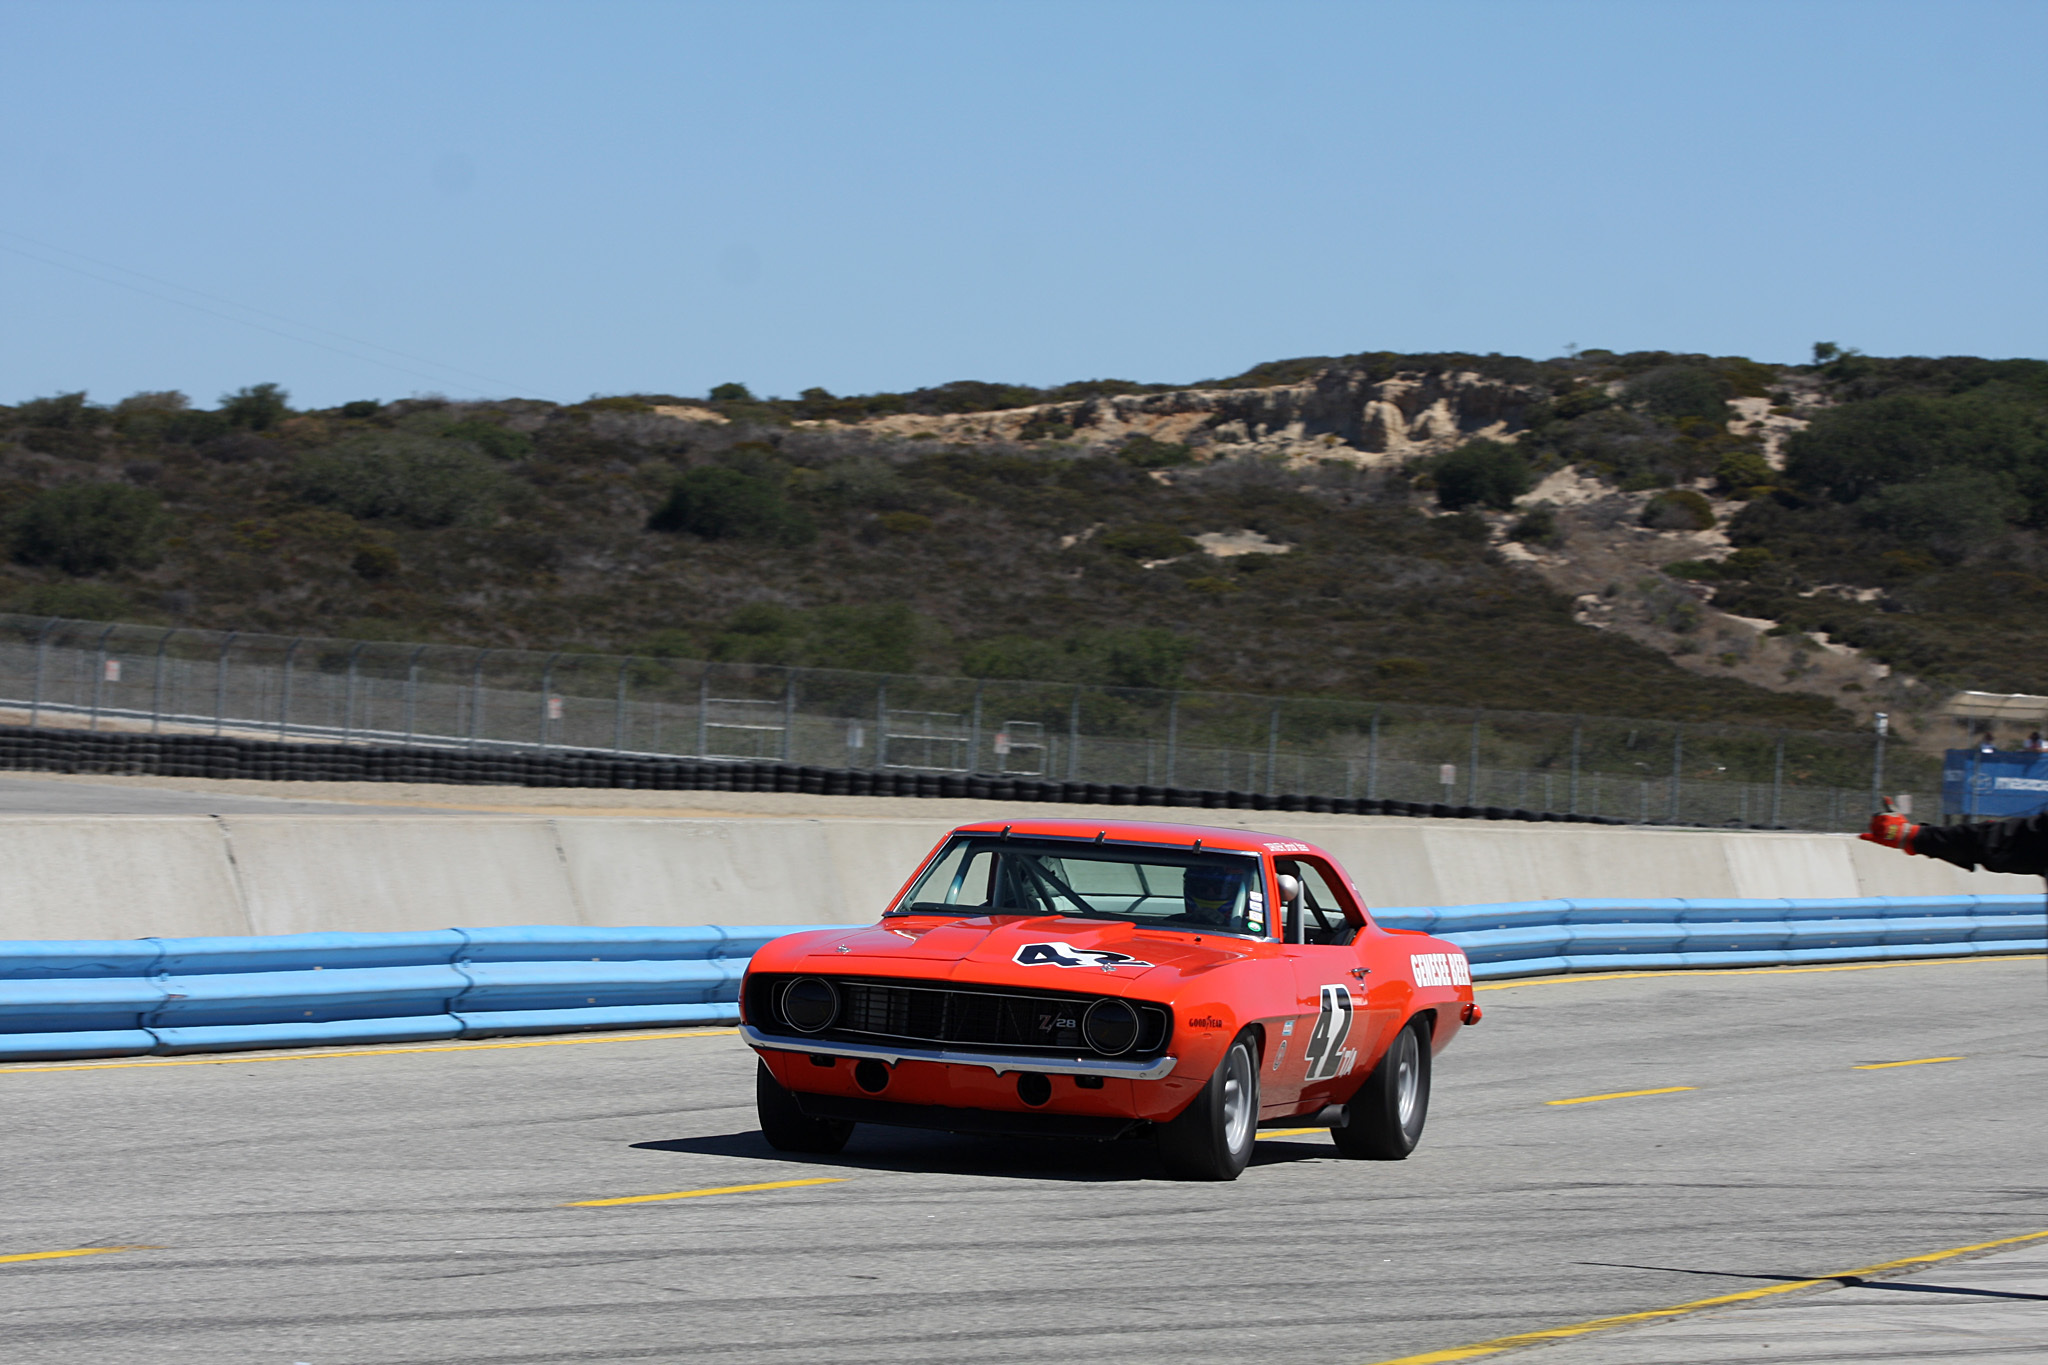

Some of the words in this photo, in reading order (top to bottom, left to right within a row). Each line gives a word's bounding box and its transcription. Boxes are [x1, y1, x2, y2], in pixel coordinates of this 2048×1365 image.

[1012, 942, 1156, 968] 42
[1410, 953, 1452, 988] GENESEE
[1446, 953, 1472, 986] BEER
[1039, 1012, 1076, 1033] Z/28
[1189, 1015, 1223, 1029] GOODYEAR
[1304, 984, 1354, 1081] 42
